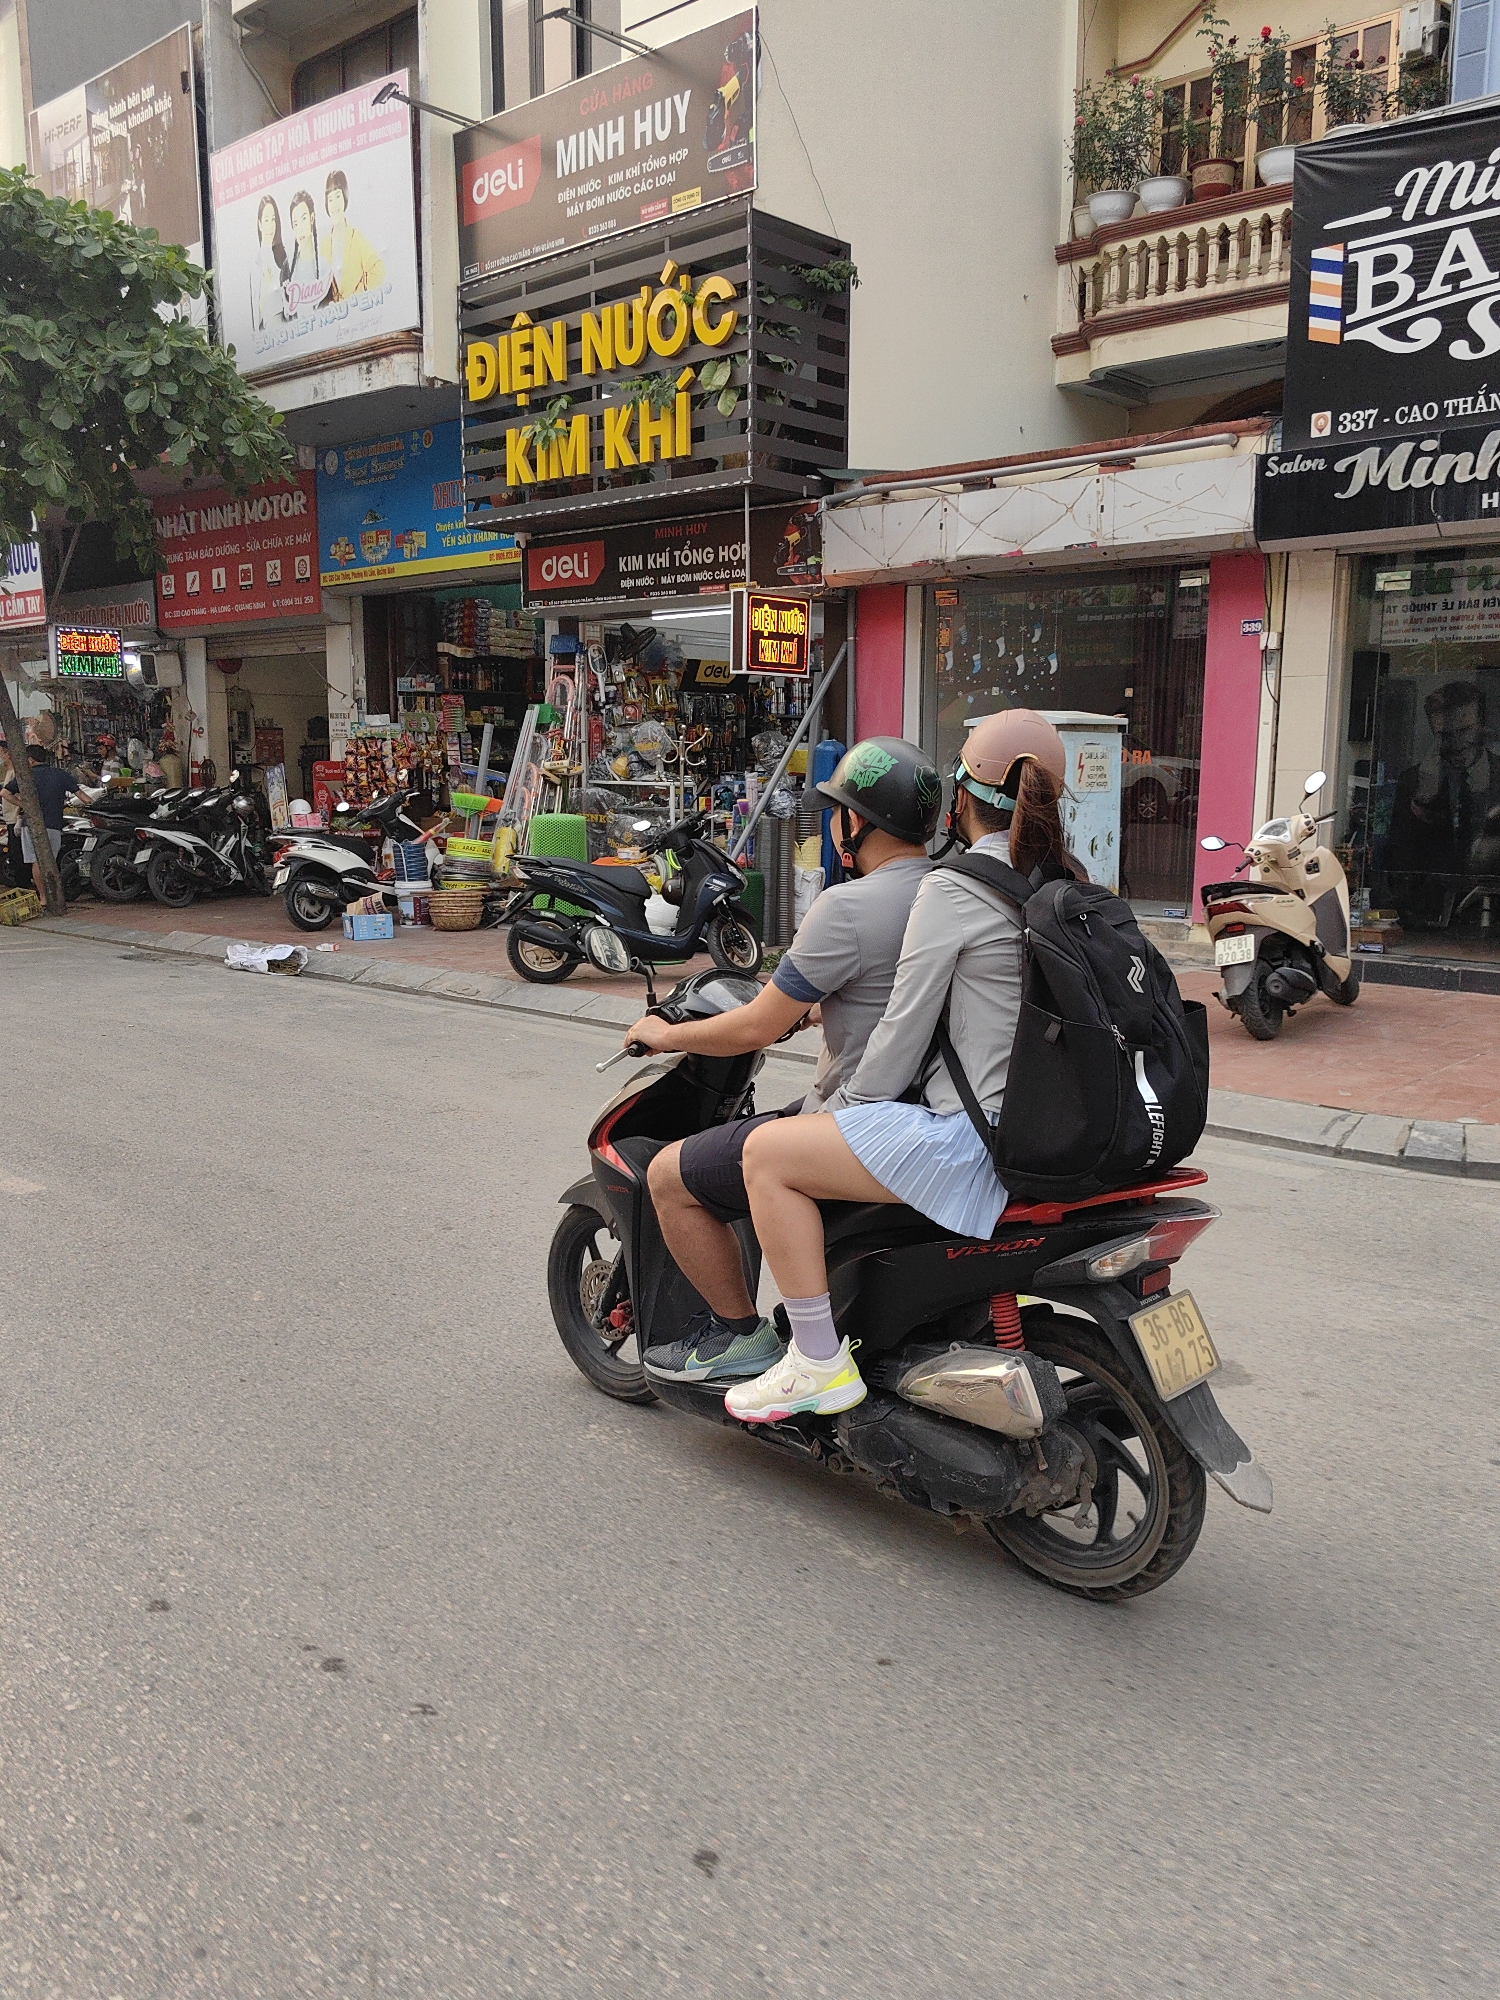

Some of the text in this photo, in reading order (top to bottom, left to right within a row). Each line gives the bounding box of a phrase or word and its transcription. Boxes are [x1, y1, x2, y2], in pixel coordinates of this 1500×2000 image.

[127, 93, 140, 110] bên
[579, 72, 654, 116] CỬA HÀNG
[265, 132, 285, 163] TẠP
[313, 103, 355, 141] NHUNG
[556, 89, 692, 179] MINH HUY
[473, 157, 525, 205] deli
[558, 147, 689, 205] ĐIỆN NƯỚC KIM KHÍ TỔNG HỢP
[1394, 146, 1500, 222] Mi
[566, 170, 676, 218] MÁY BƠM NƯỚC CÁC LOẠI
[1346, 226, 1499, 324] BA
[288, 280, 325, 312] Diana
[465, 259, 739, 407] ĐIỆN NƯỚC
[1448, 293, 1500, 361] S
[1338, 409, 1379, 435] 337
[1394, 401, 1439, 425] CAO
[1443, 383, 1500, 418] THẮN
[505, 367, 696, 487] KIM KHÍ
[1265, 453, 1328, 477] Salon
[156, 490, 308, 541] NHẬT NINH MOTOR
[1481, 491, 1500, 509] H
[164, 551, 183, 564] RUNG
[284, 534, 294, 546] XE
[295, 528, 312, 544] MÁY
[442, 532, 456, 548] YẾN
[655, 522, 708, 539] MINH HUY
[541, 552, 589, 582] deli
[618, 554, 643, 572] KIM
[647, 546, 670, 569] KHÍ
[673, 540, 714, 566] TỔNG
[620, 567, 747, 589] ĐIỆN NƯỚC MÁY BƠM NƯỚC CÁC LOẠ
[6, 593, 41, 617] CẦM TAY
[123, 597, 151, 626] NƯỚC
[752, 603, 806, 637] ĐIỆN NƯỚC
[60, 631, 119, 654] ĐIỆN NƯỚC
[1243, 622, 1262, 632] 339
[62, 654, 119, 674] KIM KHÍ
[758, 637, 799, 664] KIM KHÍ
[1131, 749, 1153, 765] RA
[1217, 949, 1252, 965] 820.38
[1222, 937, 1248, 953] 14-B1
[1144, 1104, 1165, 1158] LEFIGHT
[946, 1236, 1046, 1260] VISION
[1140, 1293, 1161, 1306] HONDA
[1143, 1300, 1195, 1351] 36-B6
